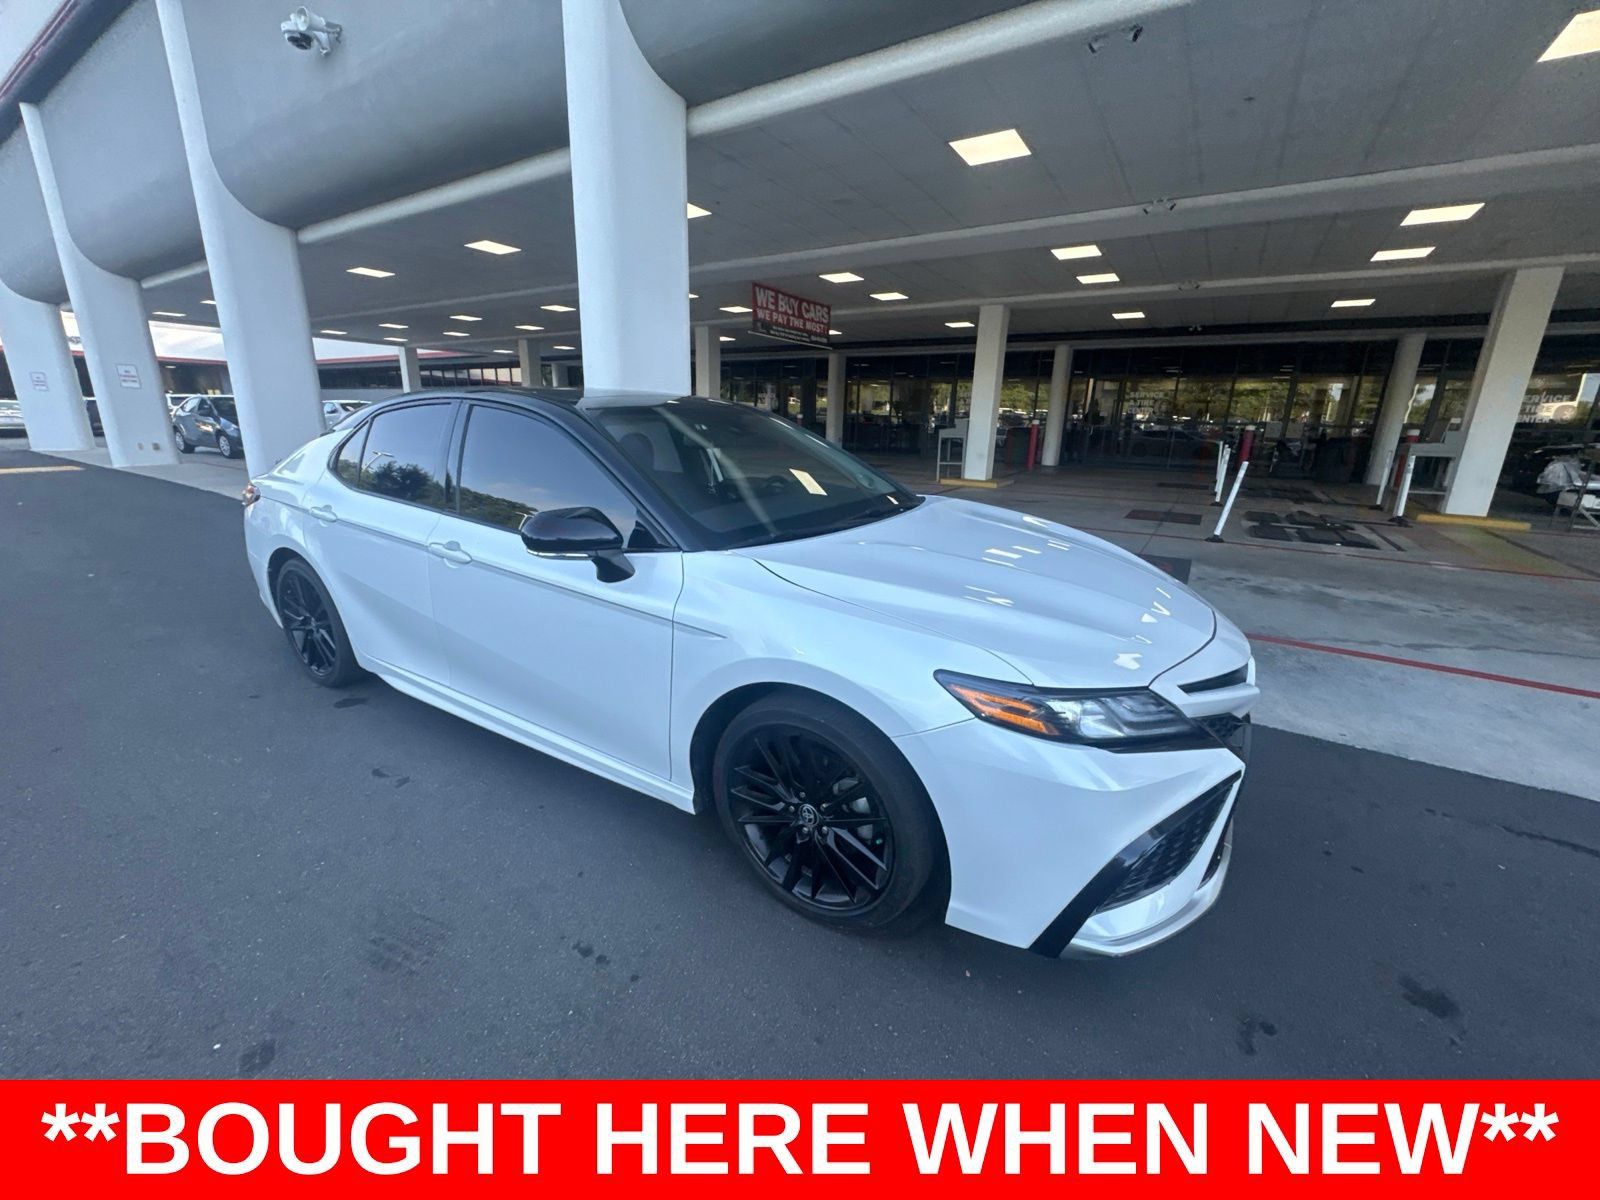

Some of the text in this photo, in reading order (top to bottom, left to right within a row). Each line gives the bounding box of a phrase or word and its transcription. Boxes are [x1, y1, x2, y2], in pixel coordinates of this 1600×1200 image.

[755, 286, 829, 323] WE BUY CARS
[757, 308, 771, 321] WE
[773, 311, 788, 325] PAY
[789, 316, 804, 329] THE
